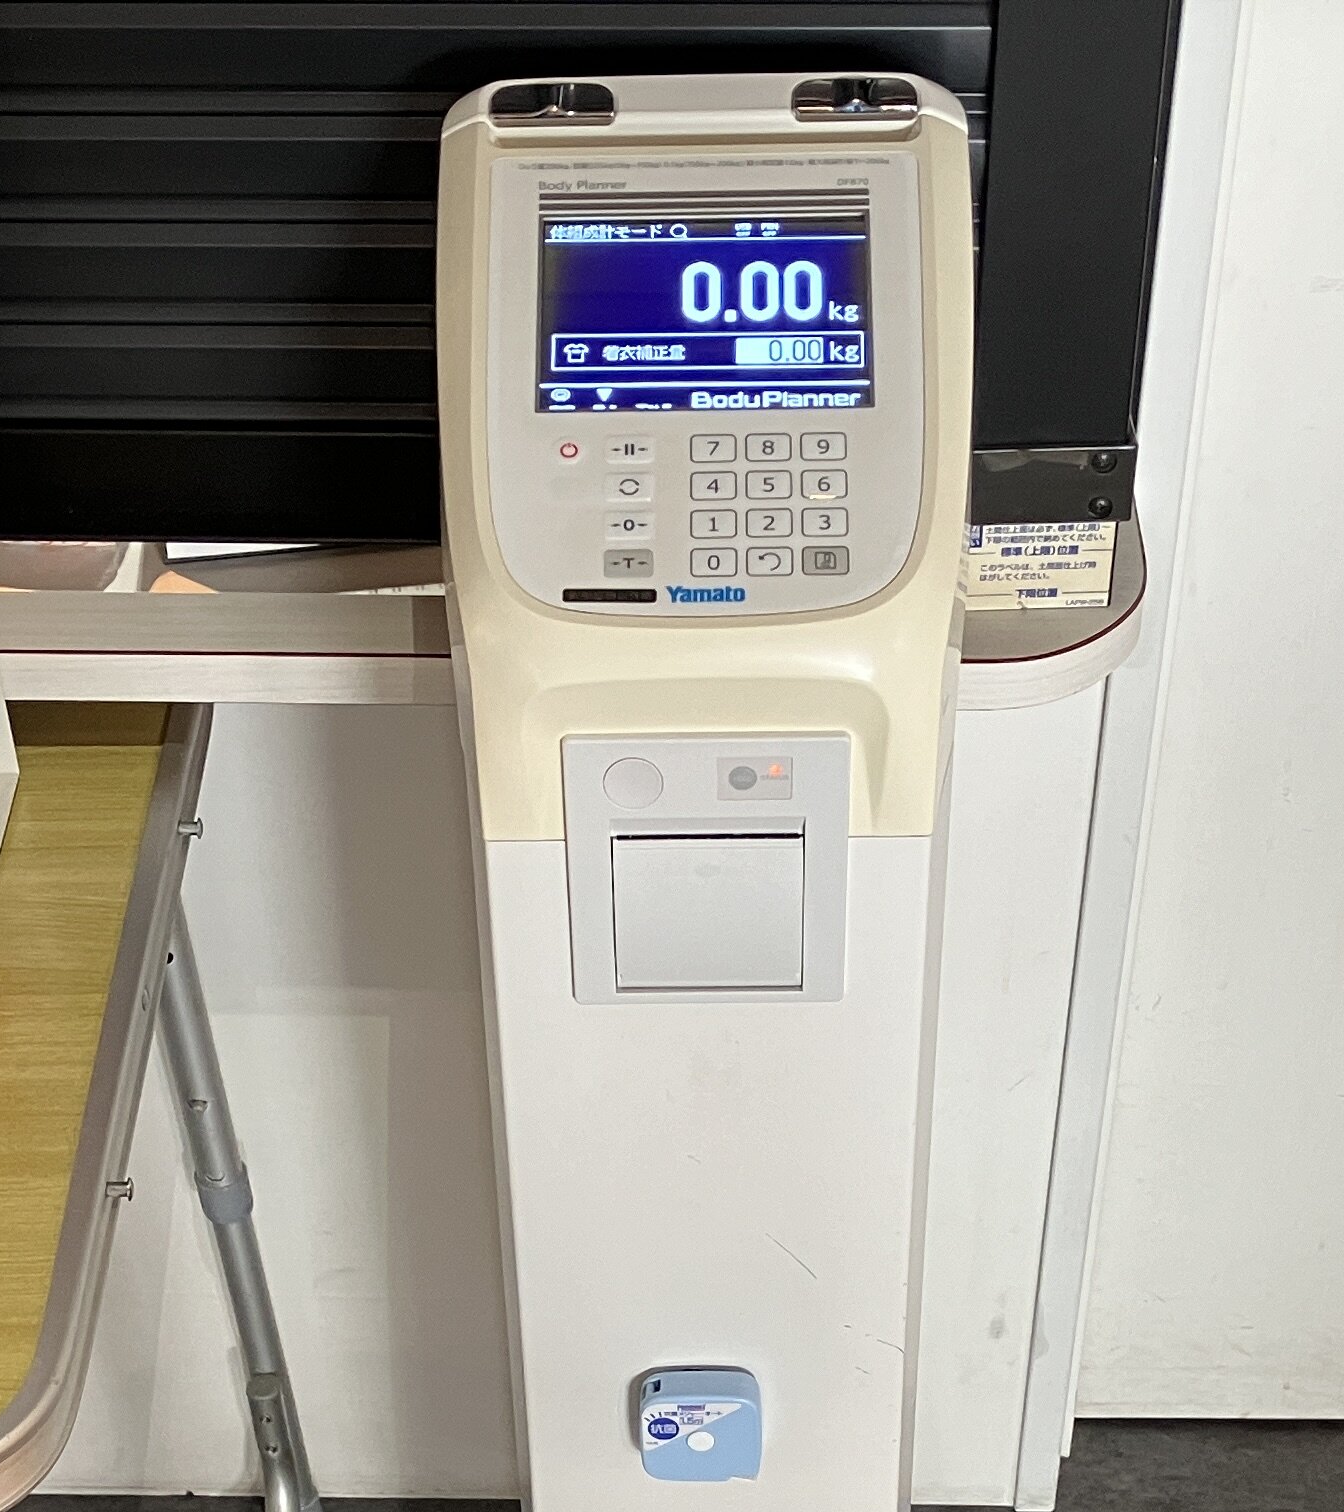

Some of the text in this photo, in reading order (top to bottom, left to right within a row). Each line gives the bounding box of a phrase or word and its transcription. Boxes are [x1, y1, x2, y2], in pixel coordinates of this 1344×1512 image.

[538, 180, 627, 192] Body Planner
[682, 260, 859, 322] 0.00 kg
[768, 339, 822, 361] 0.00
[829, 341, 860, 363] kg
[706, 439, 830, 456] 7 8 9
[706, 476, 830, 494] 4 5 6
[708, 514, 831, 532] 1 2 3
[707, 555, 720, 571] 0
[666, 586, 746, 604] Yamato
